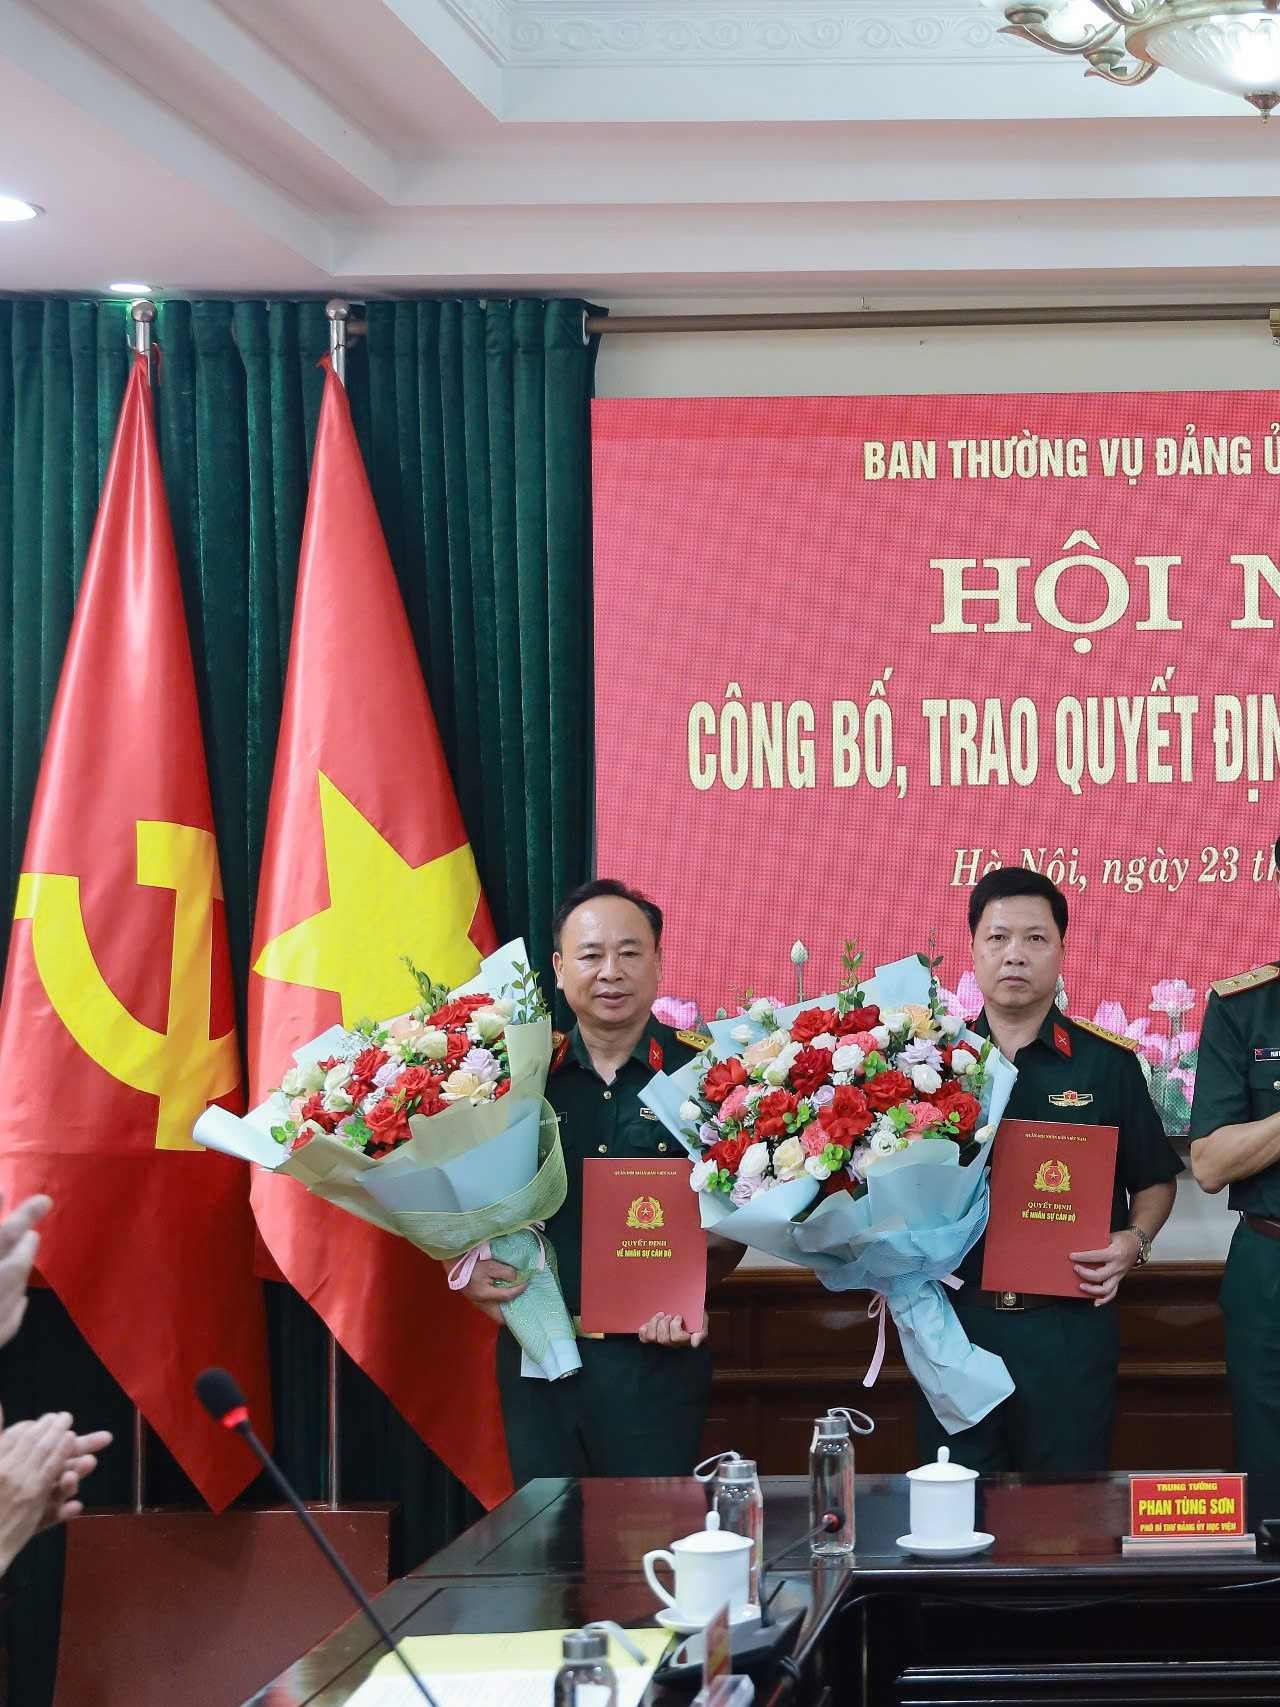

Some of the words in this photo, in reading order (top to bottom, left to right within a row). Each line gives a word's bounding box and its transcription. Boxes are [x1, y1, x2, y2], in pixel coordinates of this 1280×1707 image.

[864, 440, 936, 480] BAN
[948, 429, 1088, 479] THƯỜNG
[1099, 437, 1143, 485] VỤ
[1155, 423, 1252, 476] ĐẢNG
[929, 529, 1183, 654] HỘI
[688, 682, 816, 791] CÔNG
[832, 667, 908, 799] BỐ,
[922, 697, 1039, 787] TRAO
[1055, 666, 1200, 795] QUYẾT
[949, 848, 1002, 886] Hà
[1102, 847, 1190, 893] ngày
[1198, 846, 1240, 883] 23
[1138, 1499, 1172, 1516] PHAN
[1209, 1497, 1235, 1515] SƠN
[1156, 1483, 1186, 1492] TRUNG
